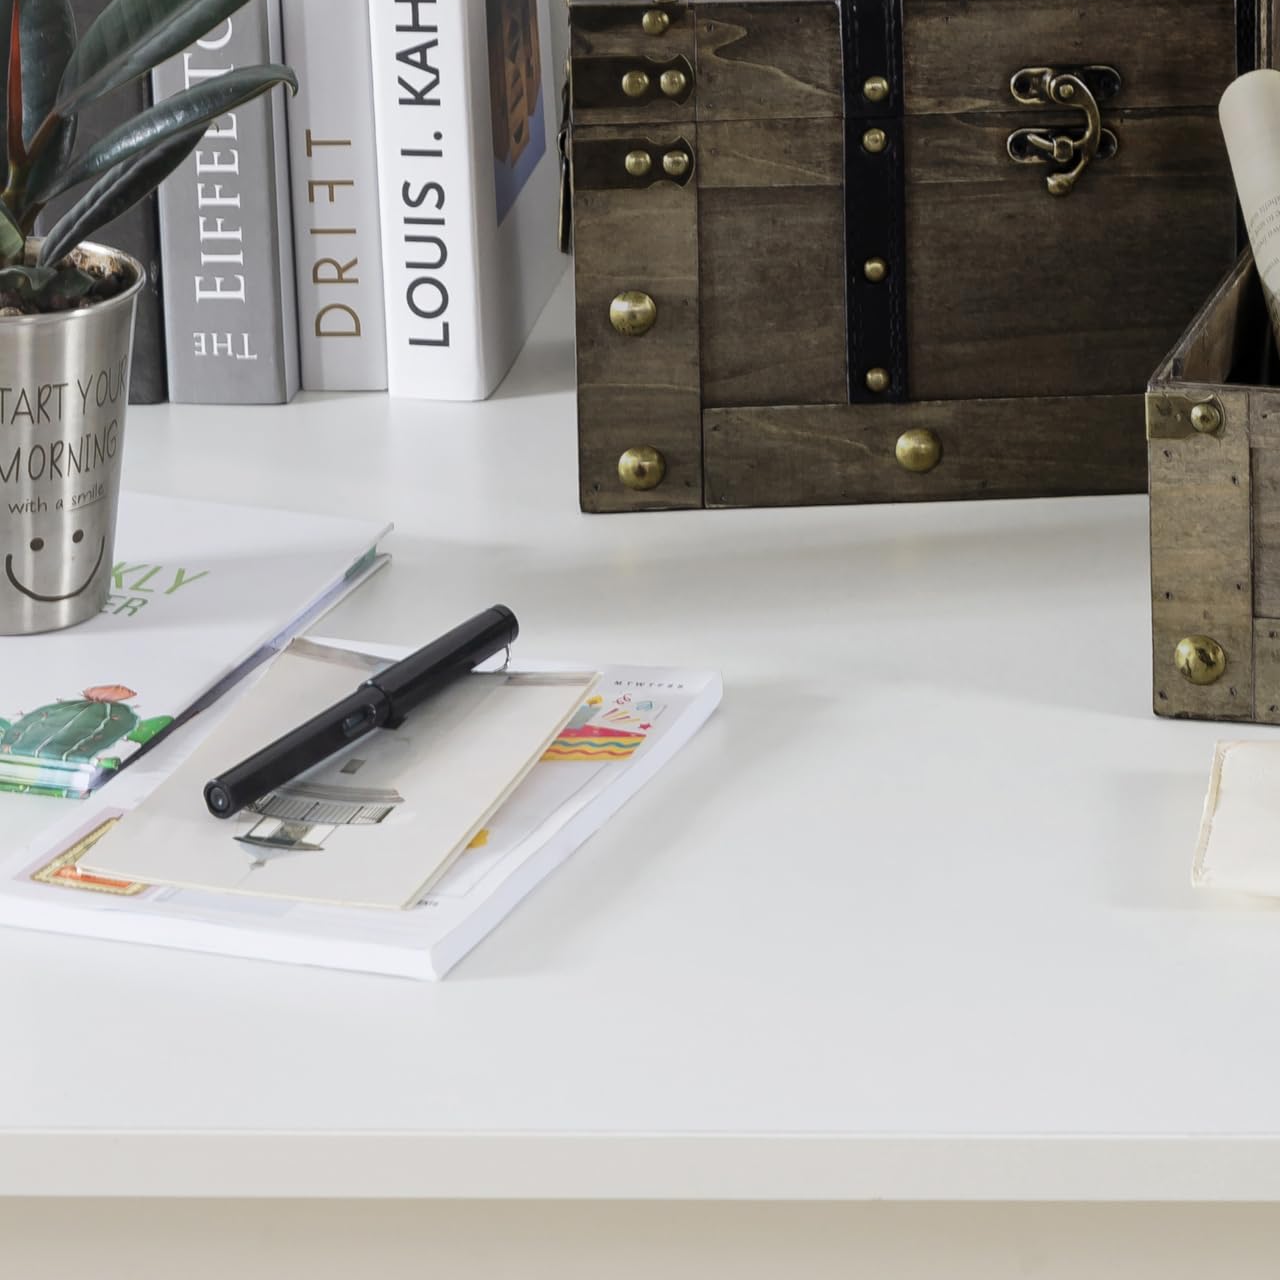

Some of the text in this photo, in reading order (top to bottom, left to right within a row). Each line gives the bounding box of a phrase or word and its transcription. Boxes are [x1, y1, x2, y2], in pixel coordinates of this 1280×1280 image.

[305, 129, 362, 339] DRIFT
[402, 181, 450, 348] LOUIS
[194, 331, 257, 361] THE
[0, 355, 128, 426] TART YOUR
[0, 418, 119, 484] MORNING
[8, 482, 106, 515] with a smile
[111, 561, 210, 594] KLY
